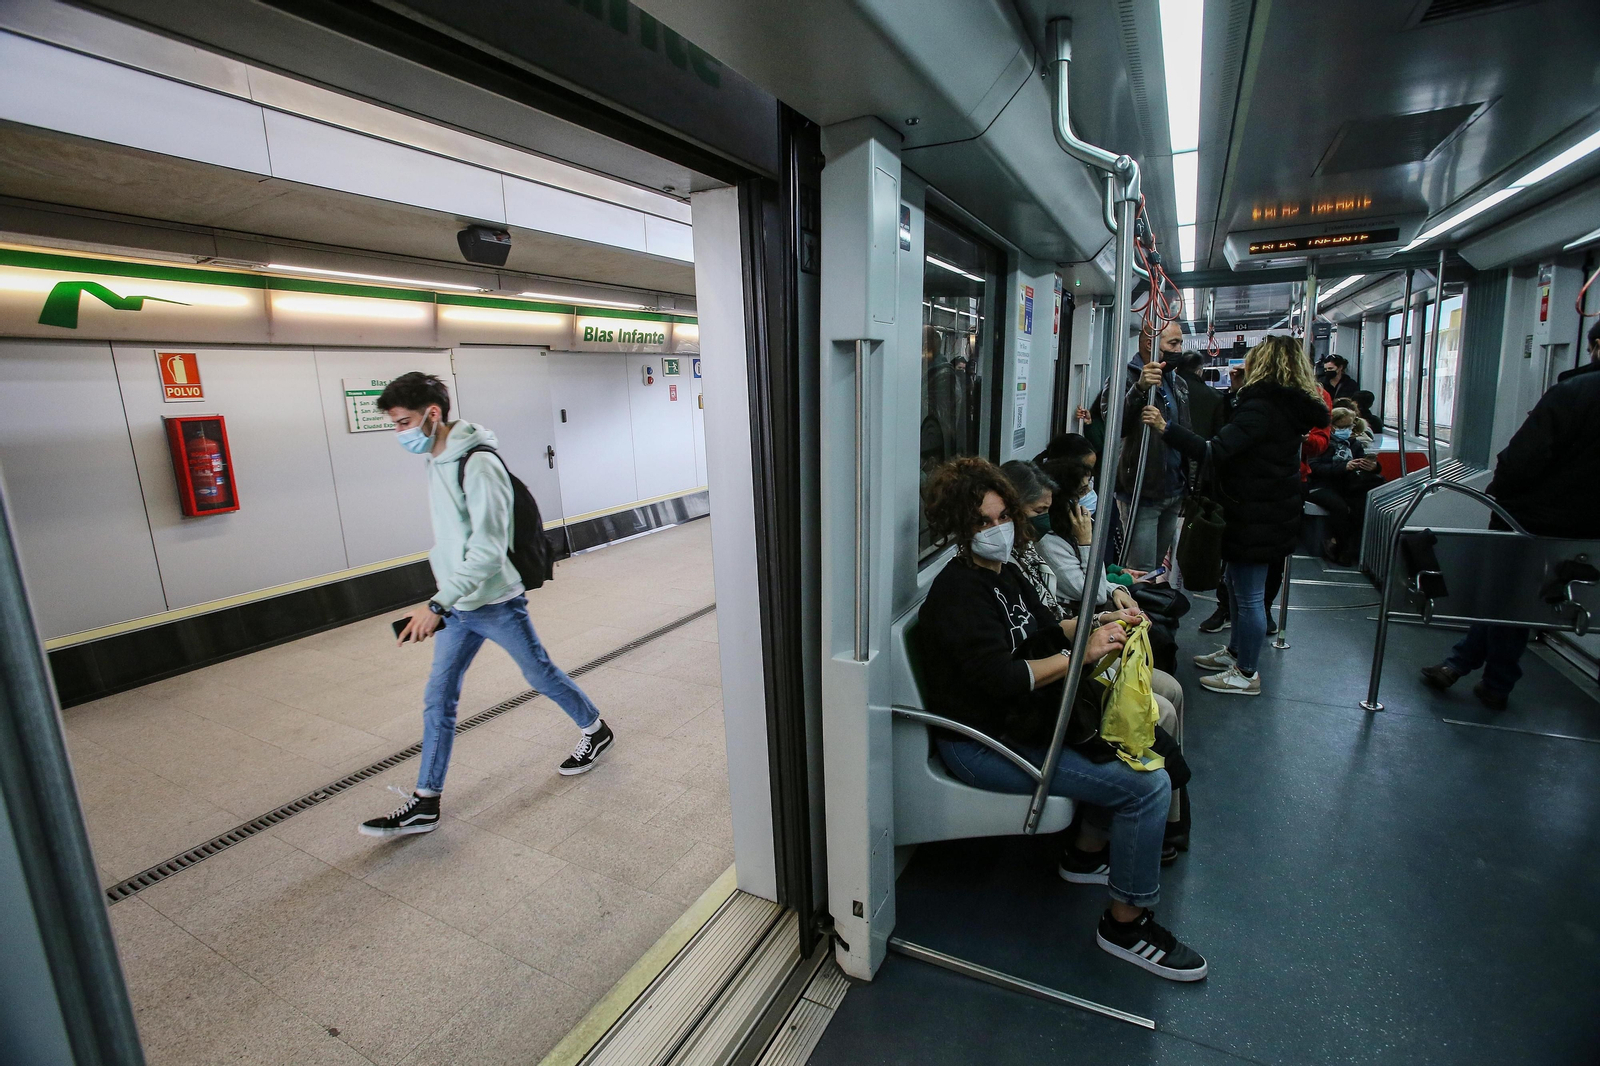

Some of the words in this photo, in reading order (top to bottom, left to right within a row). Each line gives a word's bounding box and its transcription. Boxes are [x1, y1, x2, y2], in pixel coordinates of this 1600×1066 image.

[583, 326, 614, 343] Blas
[617, 328, 665, 345] Infante
[371, 379, 388, 387] Blas
[166, 387, 200, 397] POLVO
